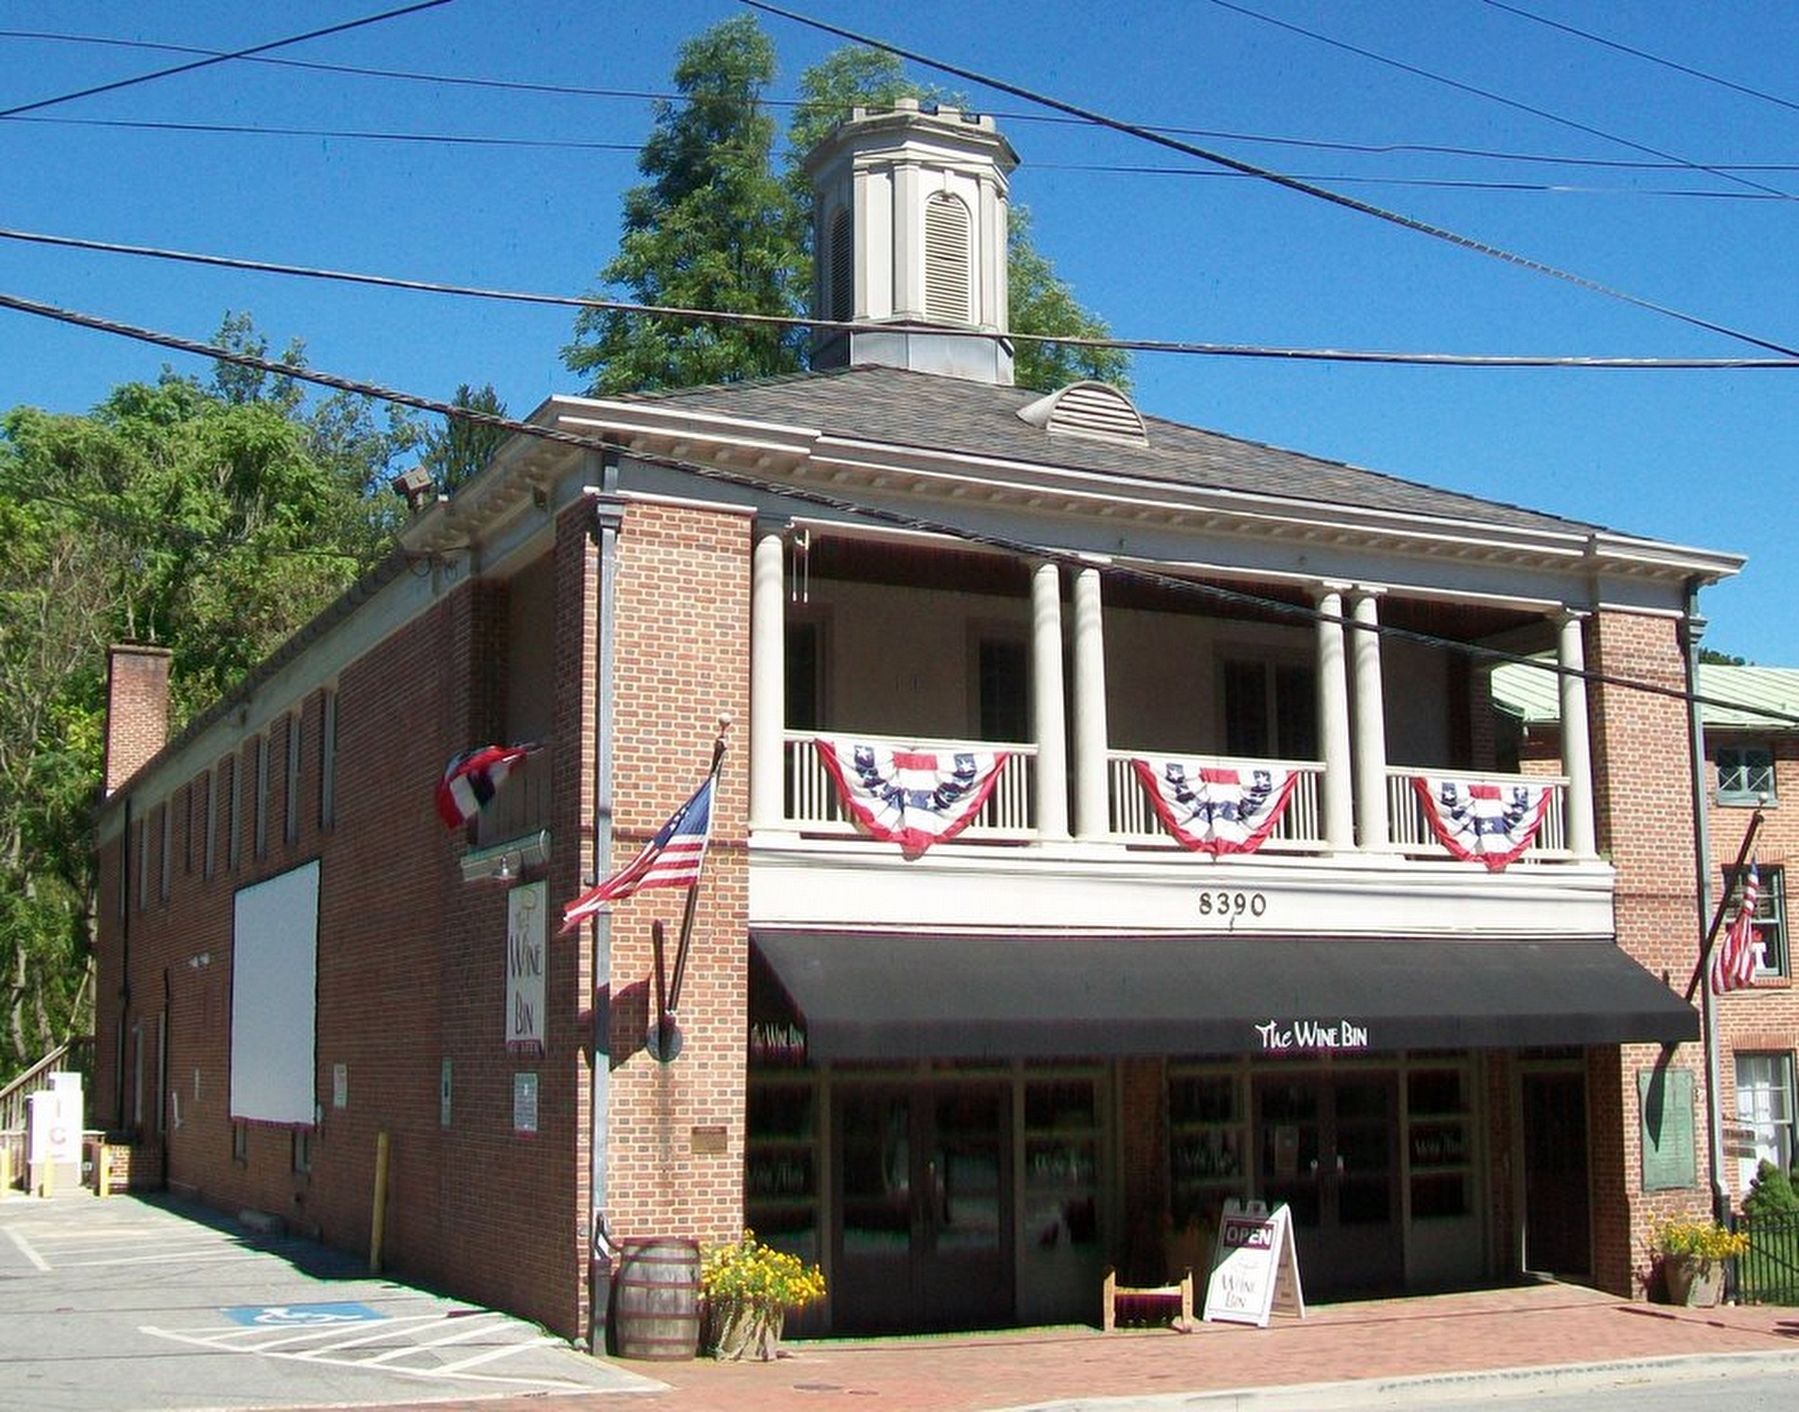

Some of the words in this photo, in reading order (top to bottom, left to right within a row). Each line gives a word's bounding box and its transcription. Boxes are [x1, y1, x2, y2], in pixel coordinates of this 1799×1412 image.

[1199, 892, 1267, 918] 8390
[1254, 1019, 1293, 1049] The
[1226, 1224, 1273, 1246] OPEN
